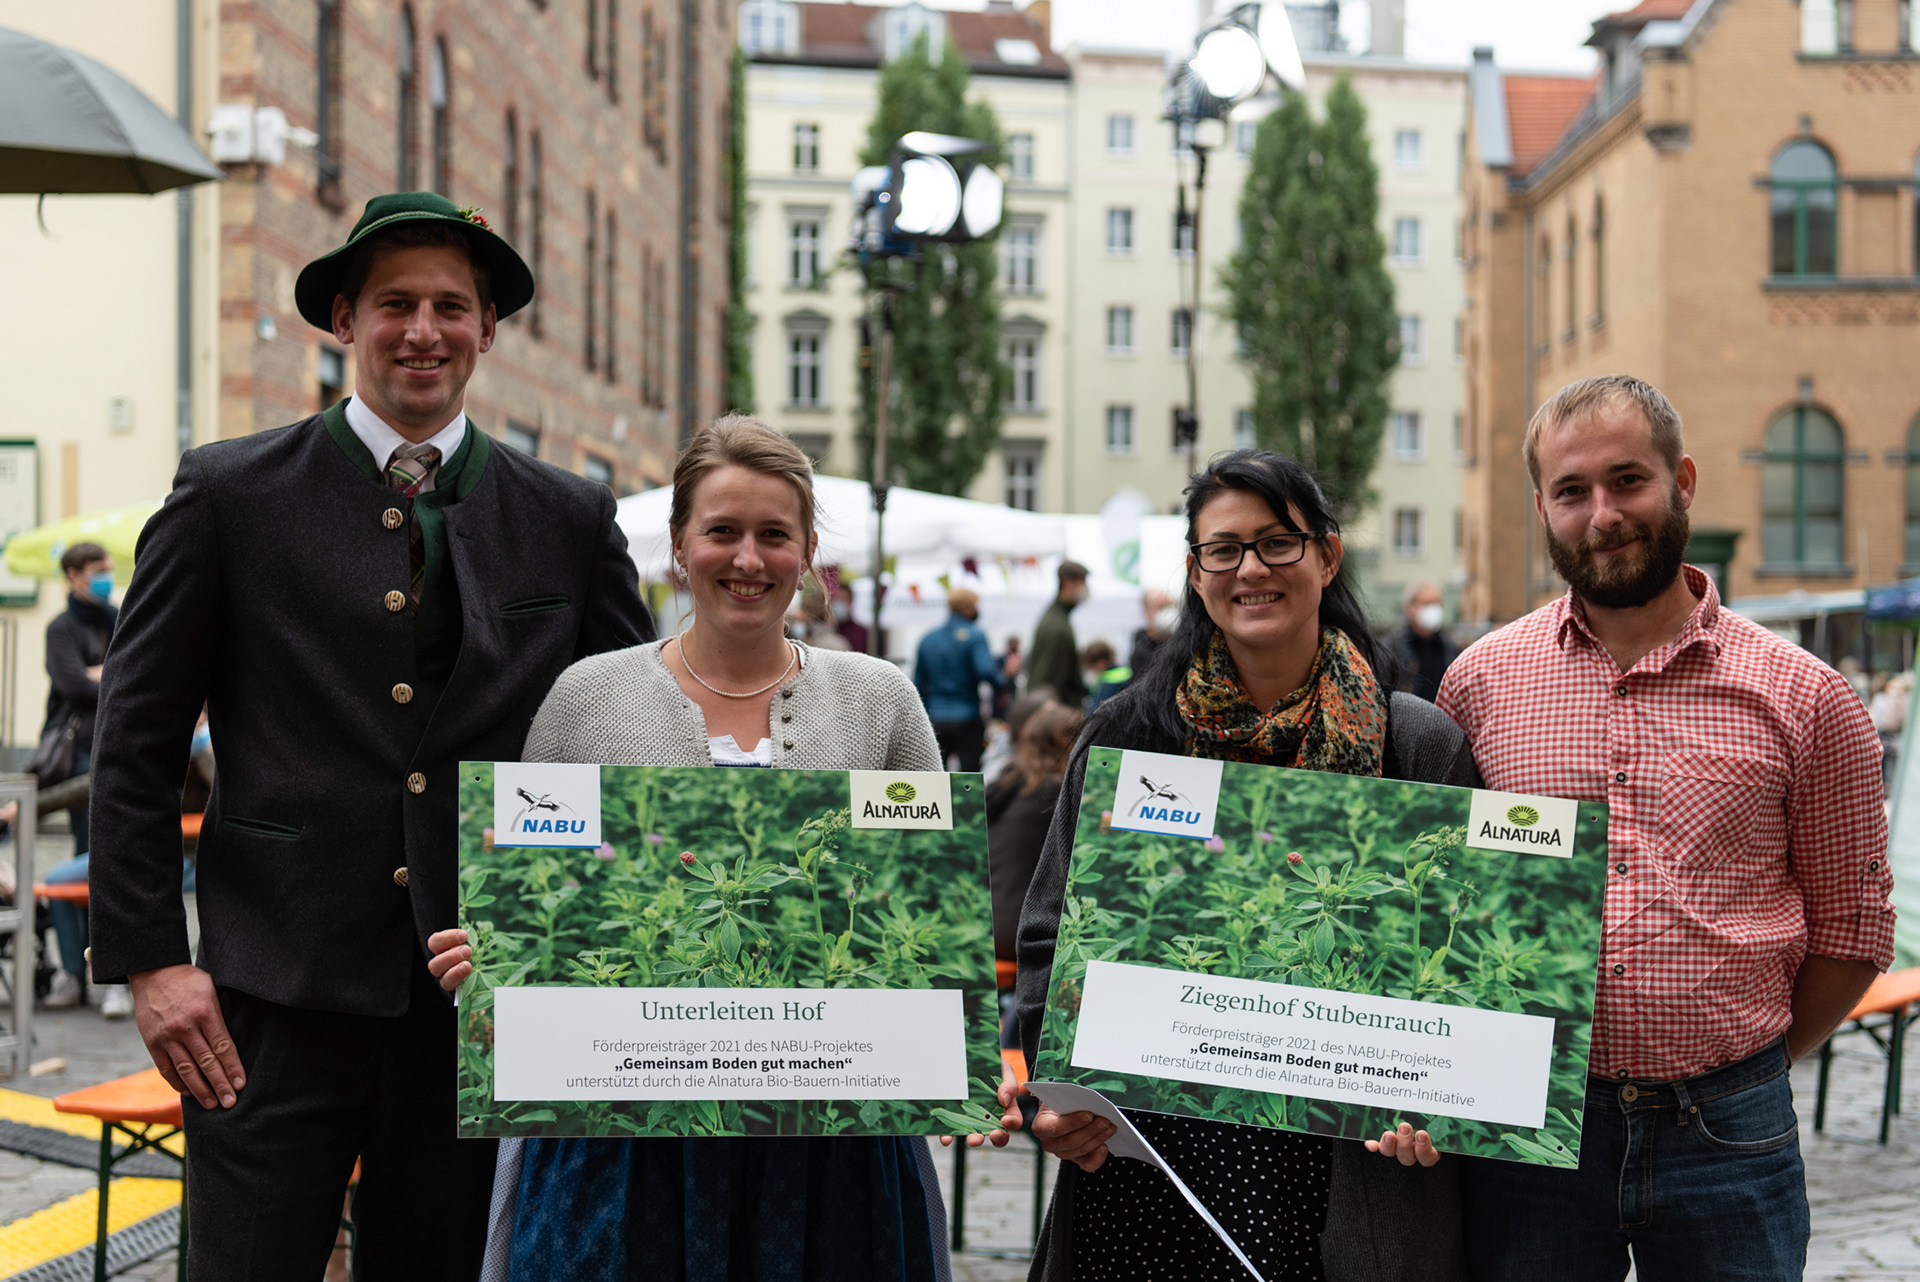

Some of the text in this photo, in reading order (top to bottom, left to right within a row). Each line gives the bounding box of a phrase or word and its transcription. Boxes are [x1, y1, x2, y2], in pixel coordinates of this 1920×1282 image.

[862, 800, 941, 819] ALNATURA
[1139, 806, 1201, 825] NABU
[522, 819, 586, 834] NABU
[1479, 820, 1562, 847] ALNATURA
[641, 1000, 827, 1021] Unterleiten Hof
[1179, 984, 1452, 1038] Ziegenhof Stubenrauch
[593, 1039, 874, 1056] Förderpreisträger 2021 des NABU-Projektes
[1172, 1021, 1452, 1069] Förderpreisträger 2021 des NABU-Projektes
[712, 1056, 758, 1070] Boden
[760, 1057, 786, 1073] gut
[1285, 1053, 1331, 1070] Boden
[1333, 1061, 1360, 1076] gut
[566, 1074, 901, 1088] unterstützt durch die Alnatura Bio-Bauern-Initiative
[1140, 1053, 1475, 1107] unterstützt durch die Alnatura Bio-Bauern-Initiative
